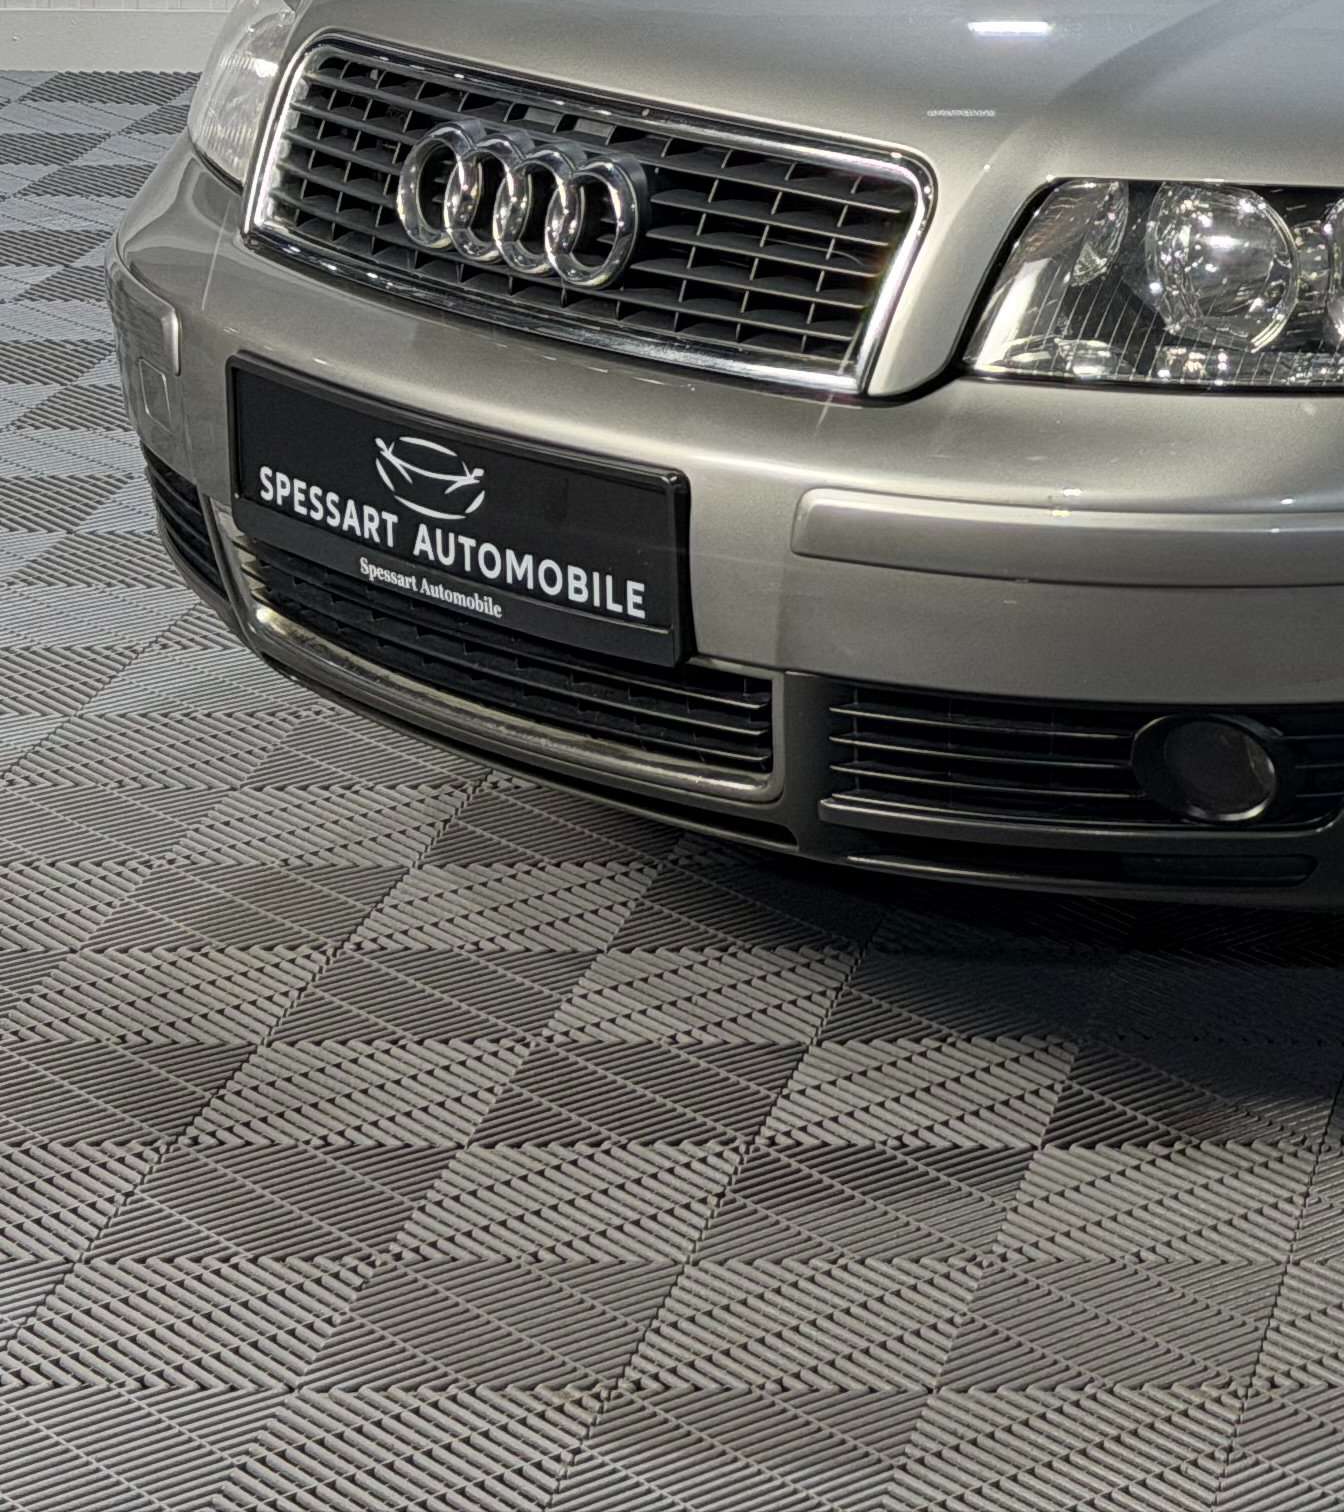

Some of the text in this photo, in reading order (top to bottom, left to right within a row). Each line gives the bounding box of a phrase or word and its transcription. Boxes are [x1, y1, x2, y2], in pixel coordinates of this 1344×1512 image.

[259, 465, 646, 619] SPESSART AUTOMOBILE
[359, 555, 502, 618] Spessart Automobile
